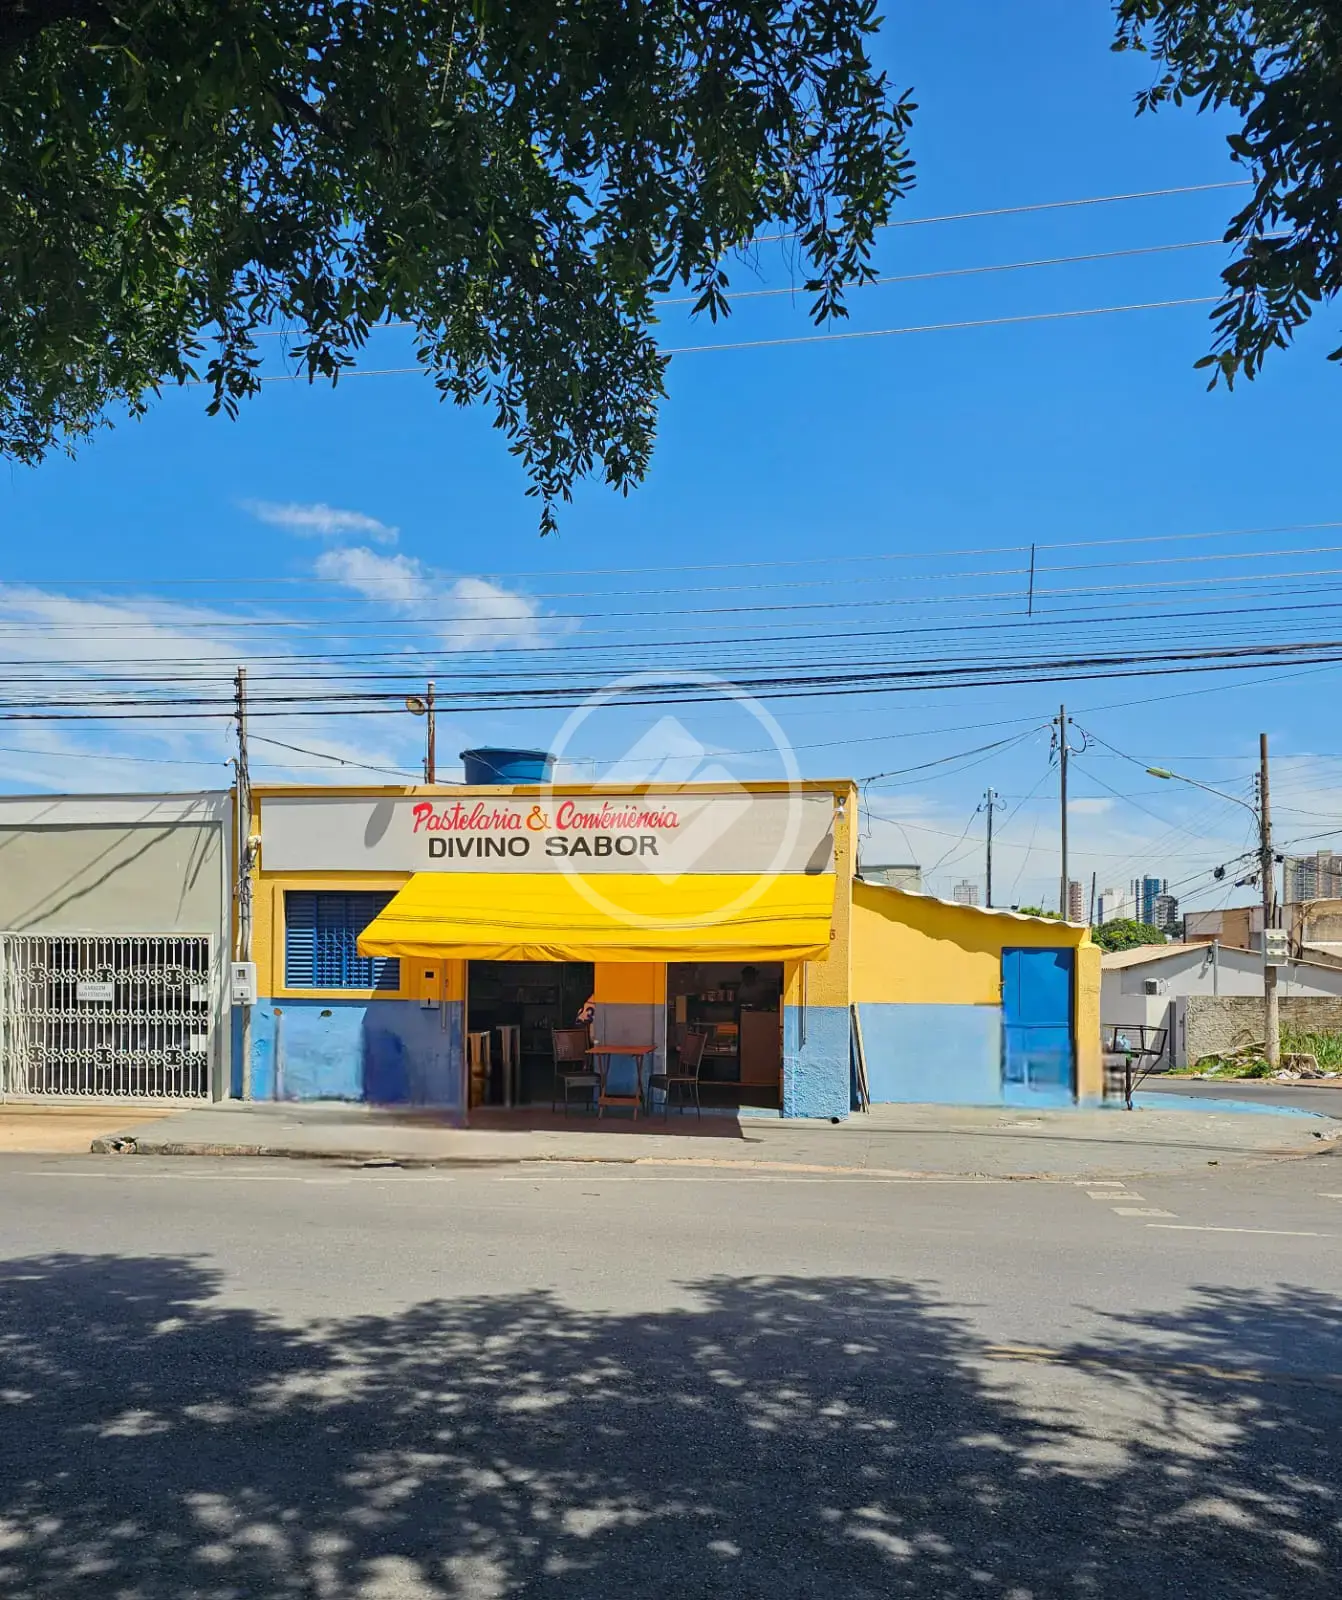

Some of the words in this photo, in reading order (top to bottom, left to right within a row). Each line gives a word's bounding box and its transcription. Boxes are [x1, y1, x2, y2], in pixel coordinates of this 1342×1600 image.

[412, 800, 522, 833] Pastelaria
[525, 804, 551, 833] &
[428, 836, 530, 858] DIVINO
[545, 835, 659, 858] SABOR
